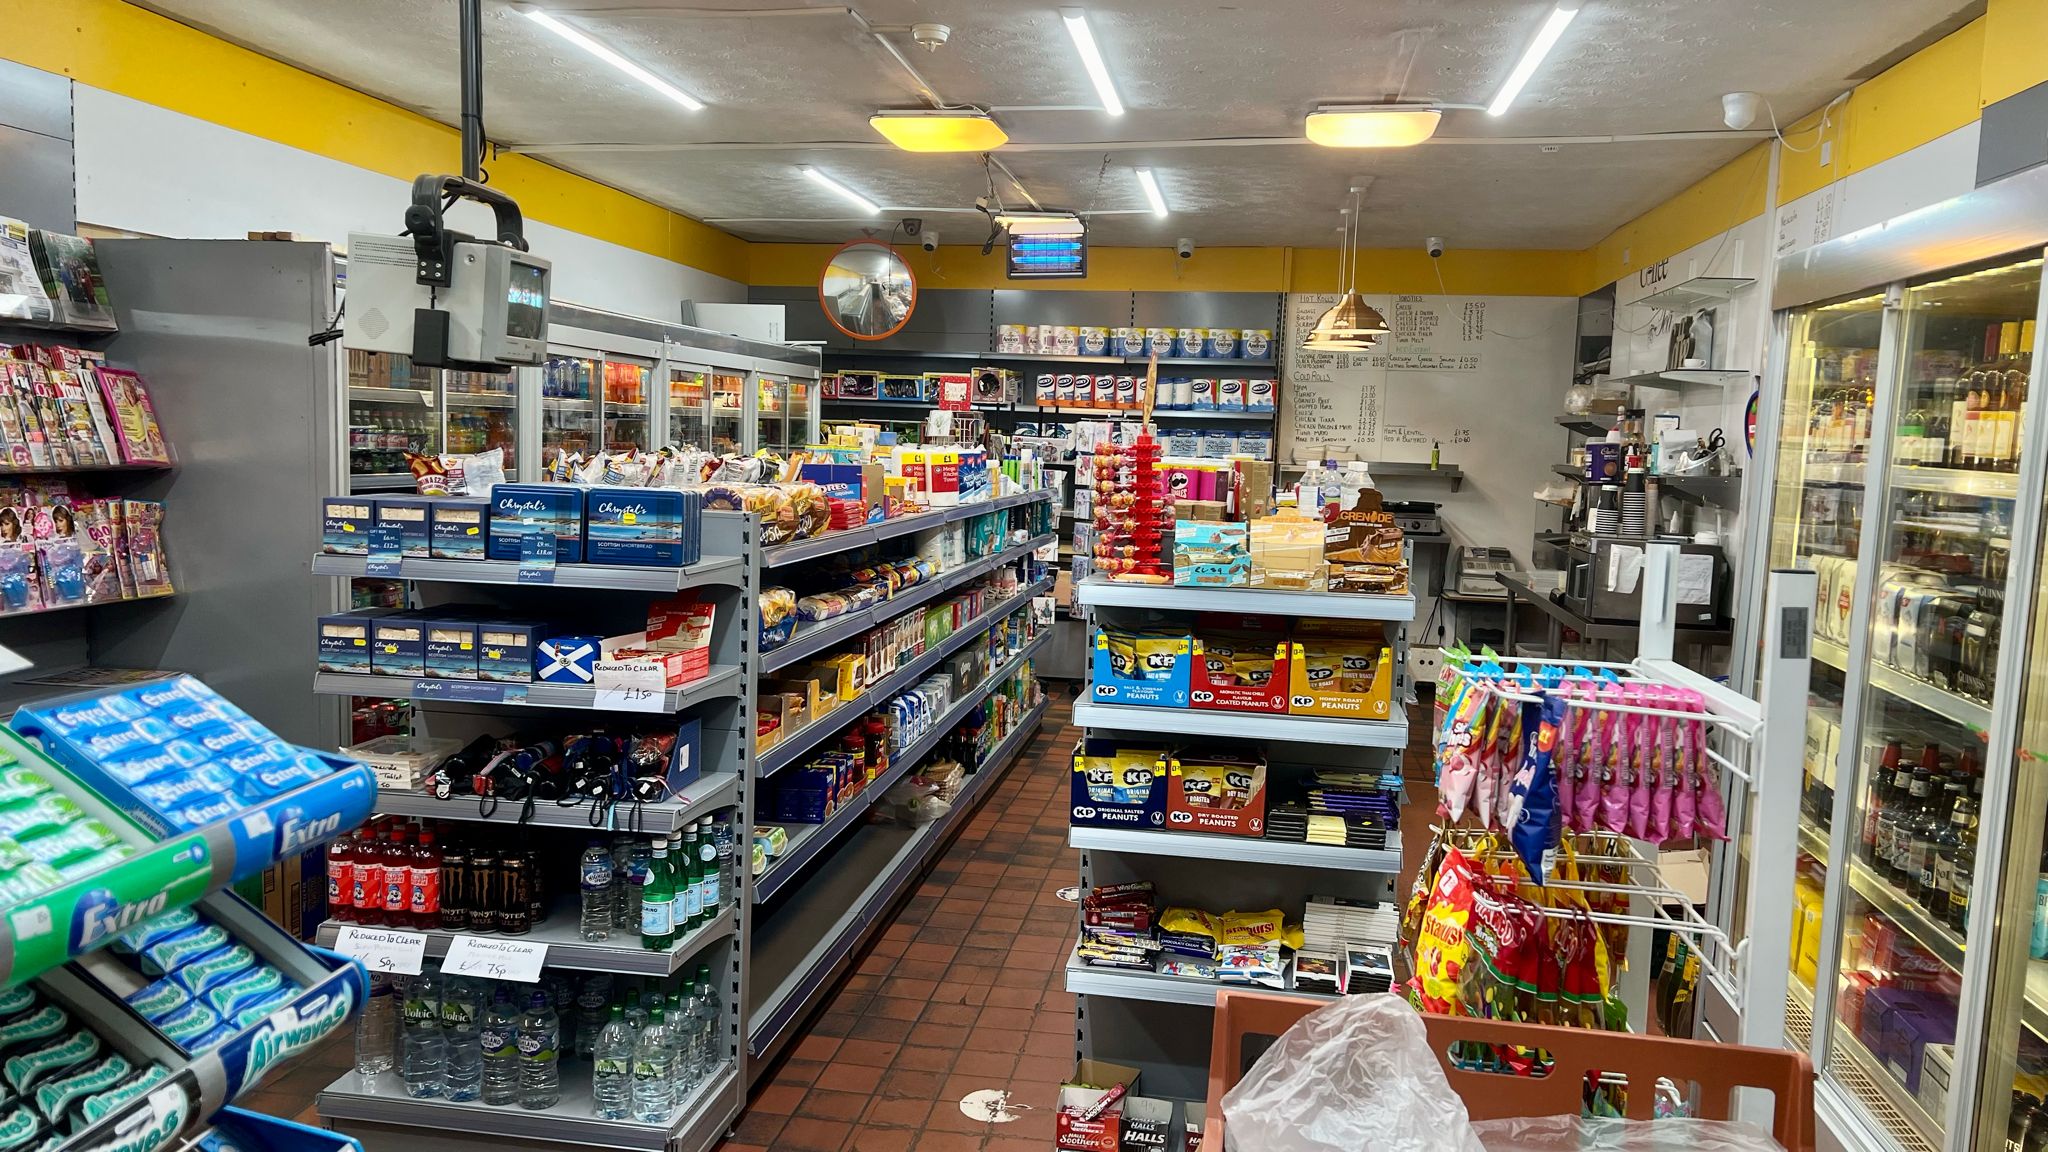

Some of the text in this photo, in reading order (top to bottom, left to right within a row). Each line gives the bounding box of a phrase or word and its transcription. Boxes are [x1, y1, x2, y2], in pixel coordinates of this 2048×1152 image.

[943, 455, 952, 463] £1
[820, 483, 848, 494] OREO
[500, 498, 548, 515] Chrystal's
[598, 502, 648, 519] Chrystal's
[434, 523, 459, 535] Chrystal's
[1979, 585, 2006, 600] GUINNE
[321, 638, 346, 648] Chrystal's
[427, 644, 452, 654] Chrystal's
[1111, 655, 1126, 666] KP
[1150, 654, 1176, 667] KP
[1207, 661, 1222, 669] KP
[1343, 659, 1367, 668] KP
[594, 662, 624, 673] REDUCED
[633, 665, 659, 673] CLEAR
[1252, 671, 1272, 679] KP
[1308, 670, 1330, 679] KP
[417, 682, 443, 692] Chrystal's
[1294, 697, 1312, 705] KP
[1321, 702, 1360, 710] PEANUTS
[1126, 772, 1151, 783] KP
[1229, 776, 1251, 787] KP
[1184, 781, 1209, 790] KP
[1102, 813, 1138, 821] PEANUTS
[1173, 813, 1190, 821] KP
[1200, 819, 1236, 827] PEANUTS
[281, 811, 341, 851] Extra
[79, 890, 167, 947] Extra
[349, 929, 387, 943] REDUCED
[395, 935, 422, 945] CLEAR
[156, 927, 224, 967] Airwaves
[467, 939, 498, 951] REDUCED
[507, 944, 534, 954] CLEAR
[182, 946, 251, 993] Airwaves
[487, 963, 506, 977] 75p
[212, 967, 280, 1016] Airwaves
[404, 1007, 432, 1020] Volvic
[442, 1009, 469, 1022] Volvic
[248, 999, 346, 1074] Airwaves
[6, 1032, 94, 1087] Airwaves
[38, 1057, 125, 1118] Airwaves
[1085, 1097, 1111, 1120] Soothers
[1131, 1122, 1155, 1131] HALLS
[1060, 1134, 1100, 1147] Soothers
[1124, 1131, 1166, 1144] HALLS
